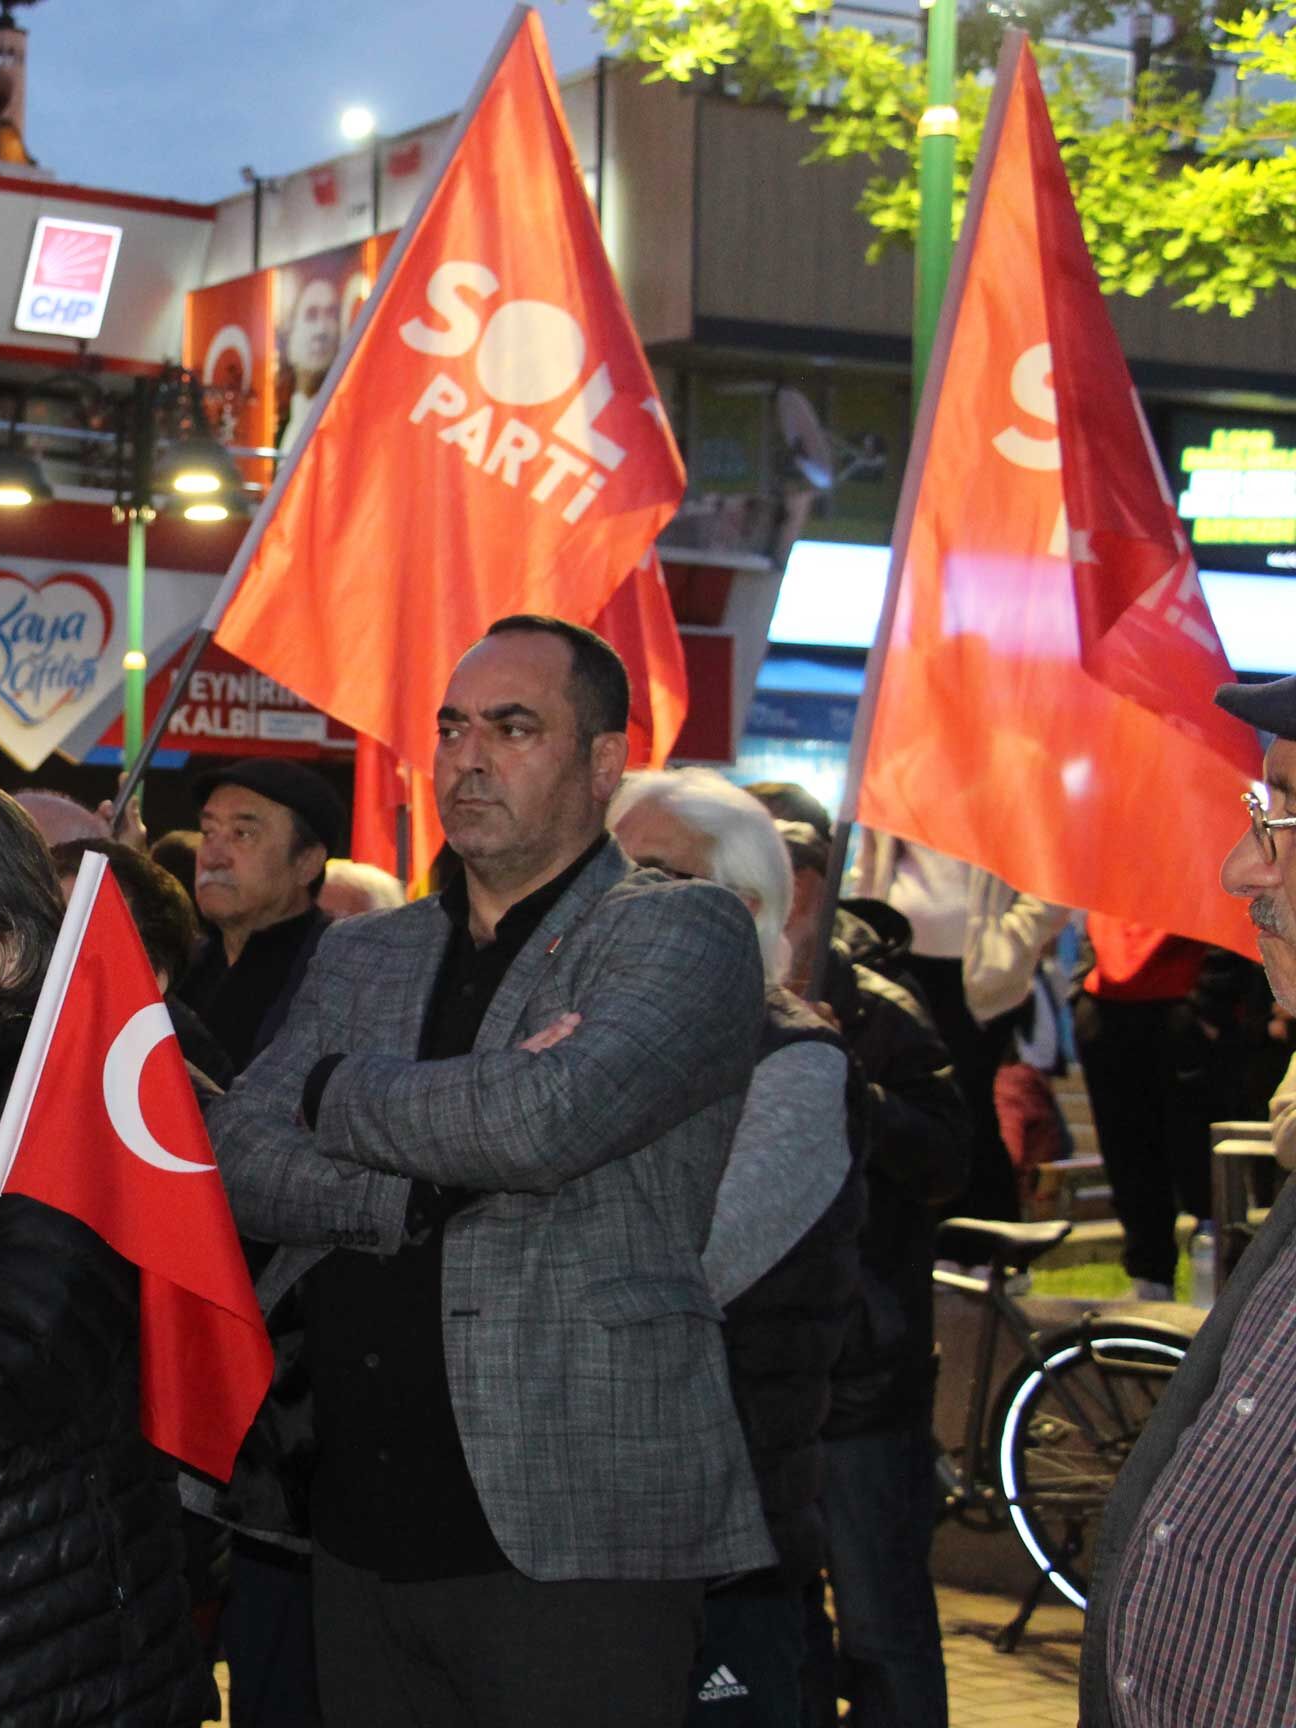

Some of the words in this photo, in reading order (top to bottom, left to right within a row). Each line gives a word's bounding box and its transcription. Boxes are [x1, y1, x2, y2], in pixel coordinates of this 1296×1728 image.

[30, 294, 96, 323] CHP
[399, 260, 627, 473] SOL
[698, 1685, 748, 1701] adidas
